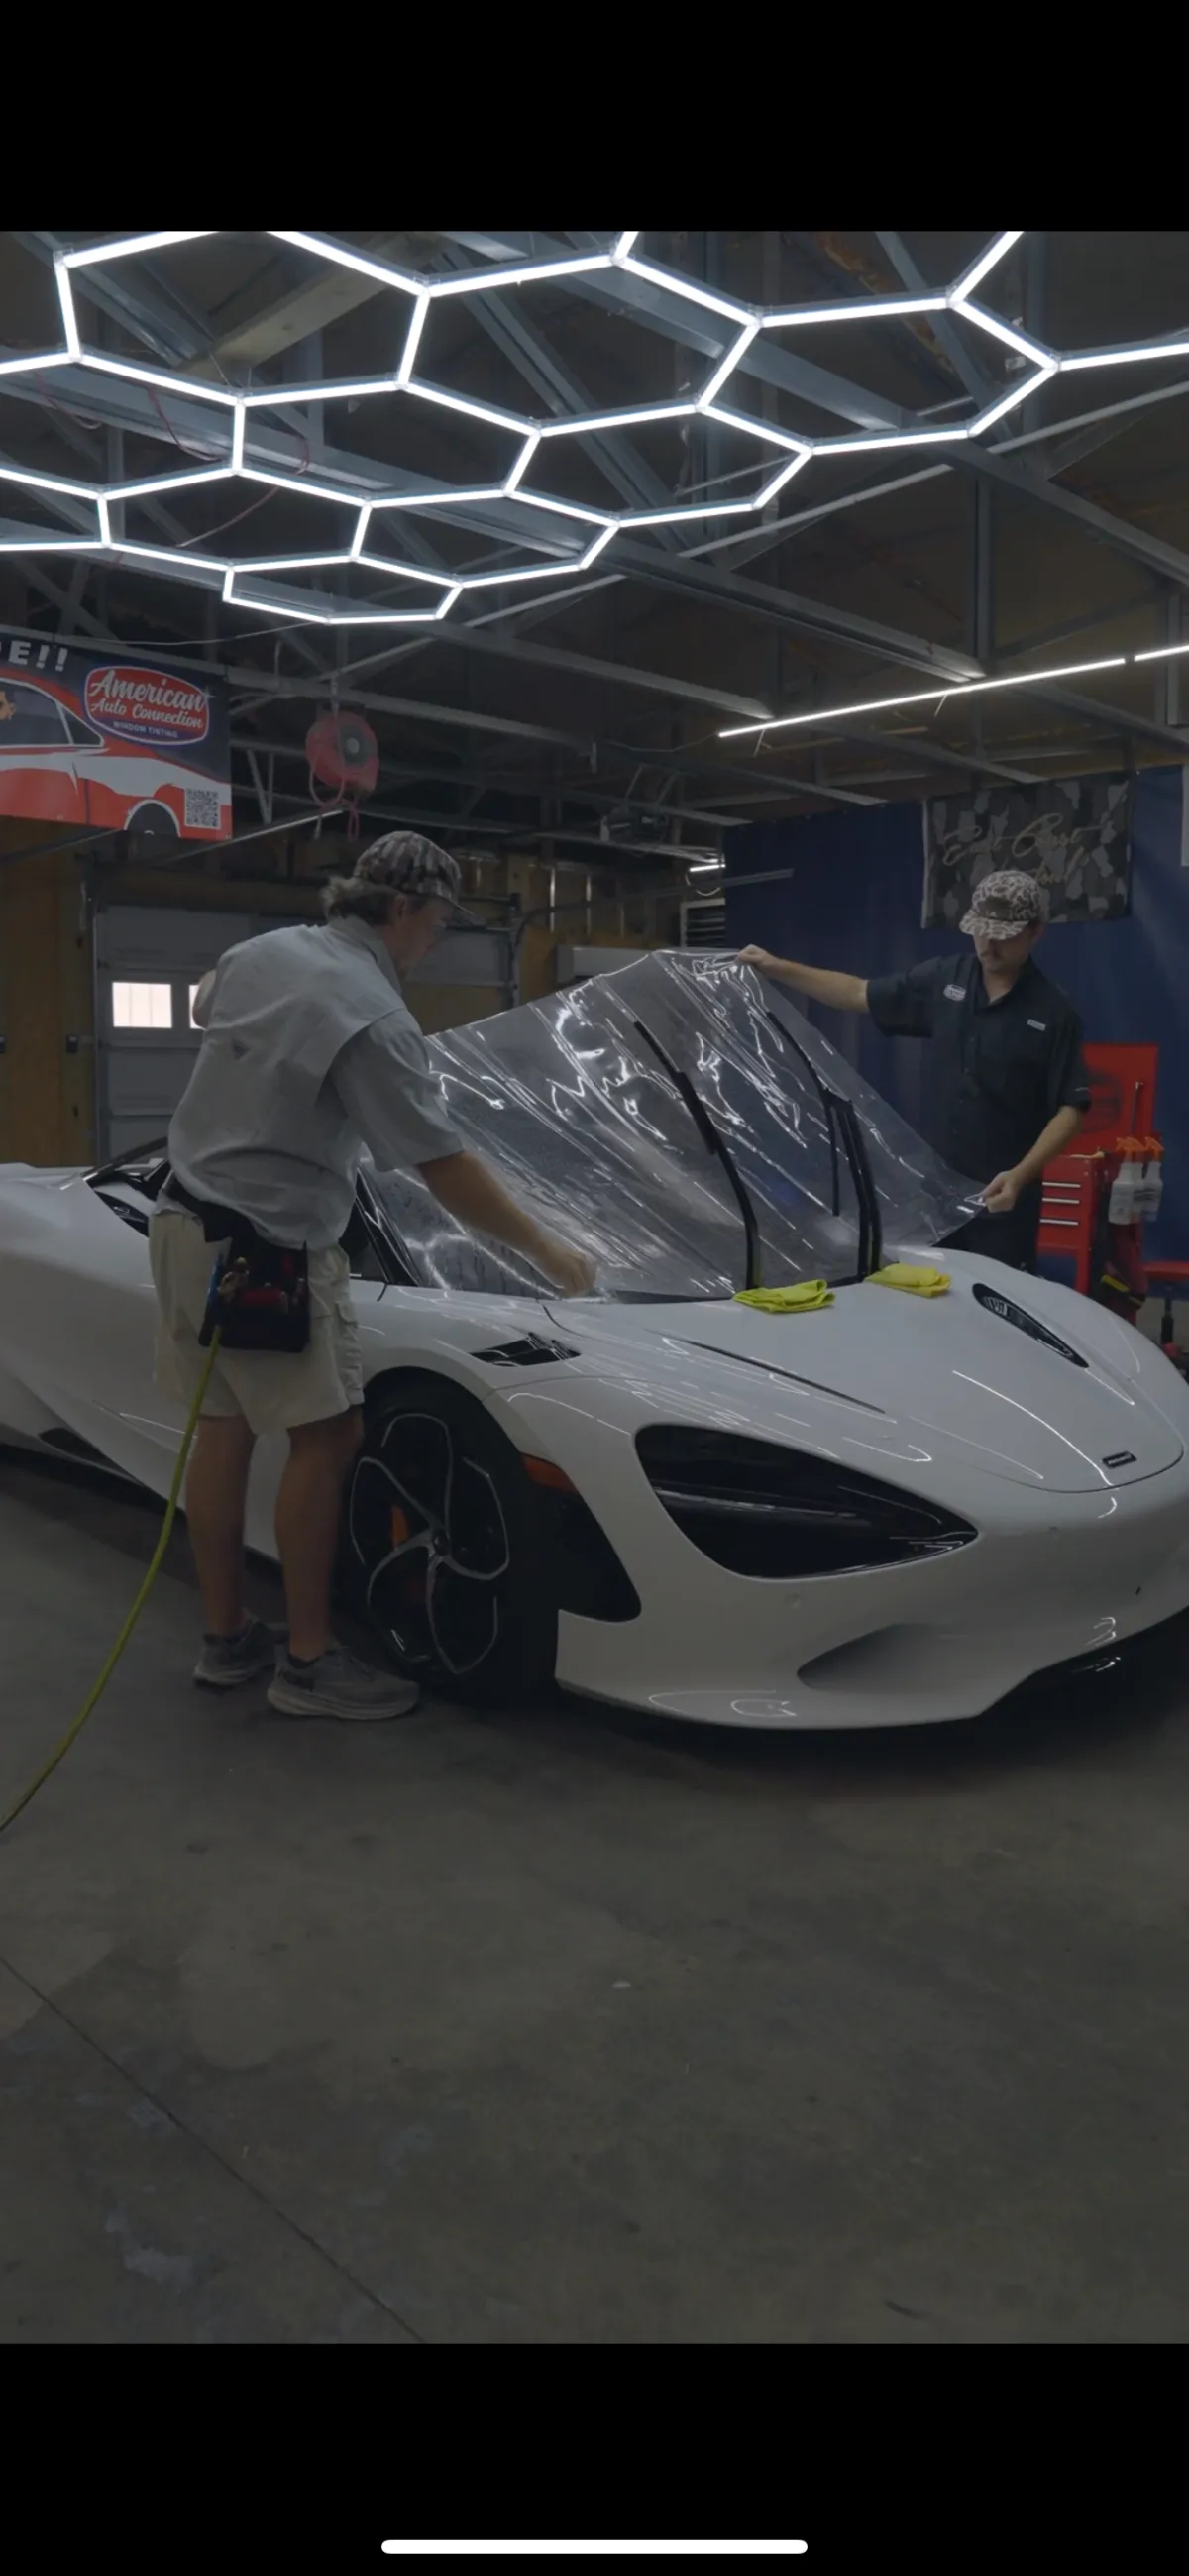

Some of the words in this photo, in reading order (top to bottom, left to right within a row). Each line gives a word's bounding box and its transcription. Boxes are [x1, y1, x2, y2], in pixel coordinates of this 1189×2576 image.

[0, 640, 68, 673] E!!
[89, 670, 205, 712] American
[90, 698, 127, 715] Auto
[132, 703, 203, 729] Connection
[113, 720, 146, 733] WINDOW
[148, 725, 178, 738] TINTING
